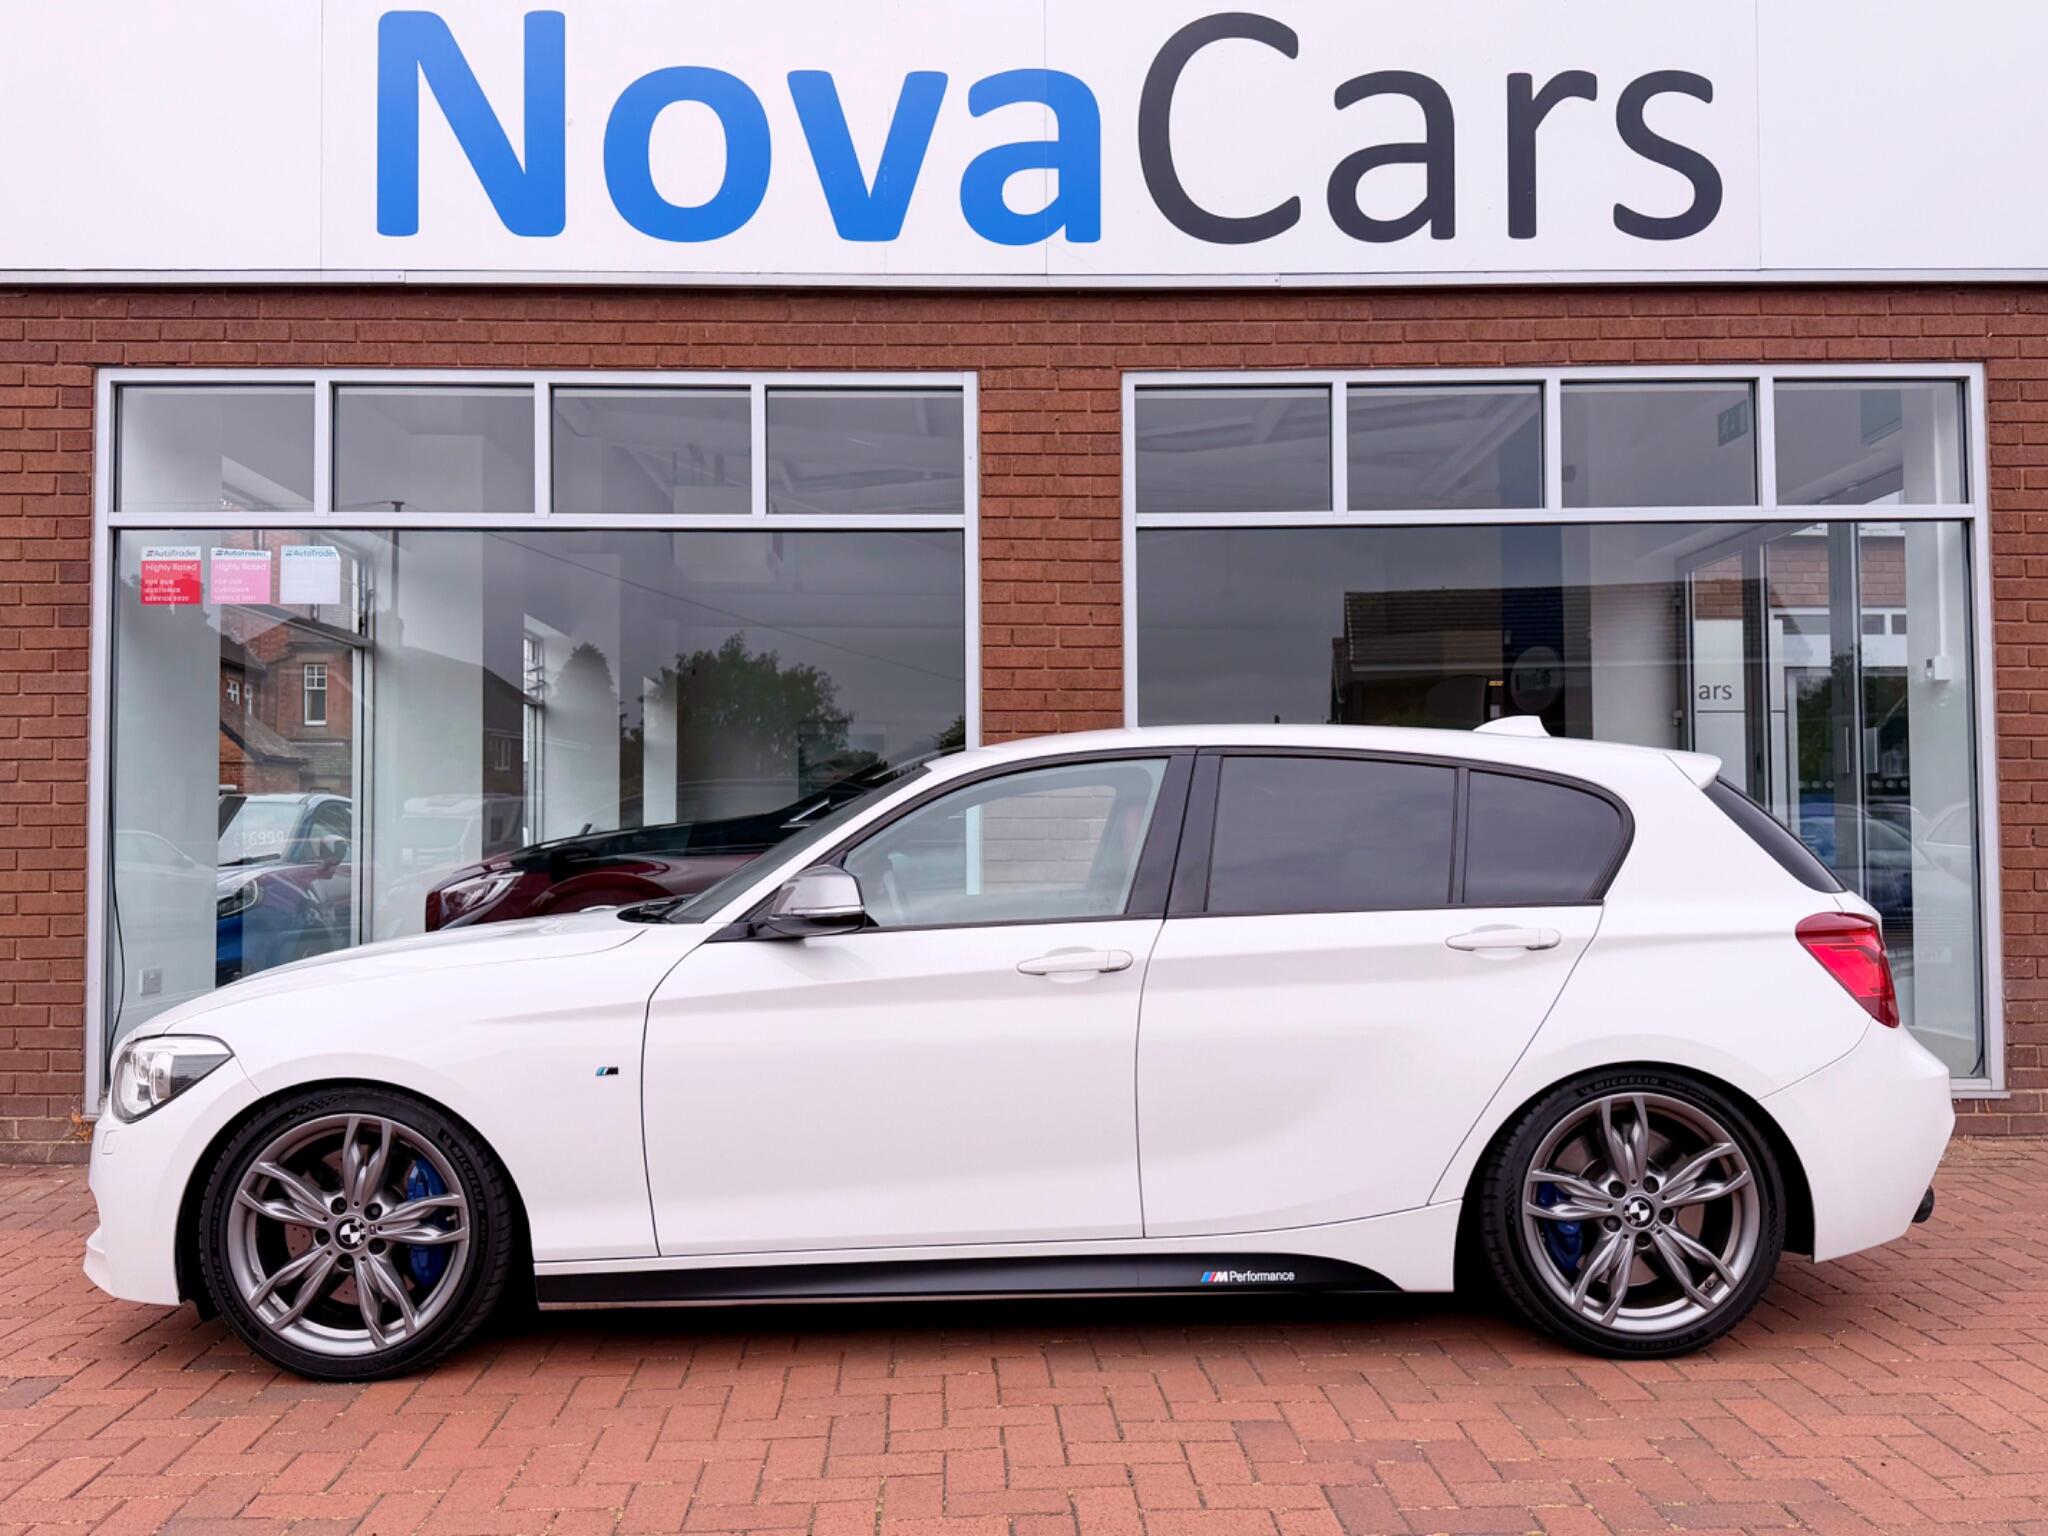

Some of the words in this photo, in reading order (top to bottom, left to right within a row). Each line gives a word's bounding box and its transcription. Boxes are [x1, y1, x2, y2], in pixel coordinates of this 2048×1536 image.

[154, 549, 197, 558] AutoTrader
[145, 562, 171, 573] Highly
[173, 562, 197, 571] Rated
[241, 562, 266, 571] Rated
[1698, 684, 1733, 701] ars
[1229, 1270, 1295, 1282] Performance
